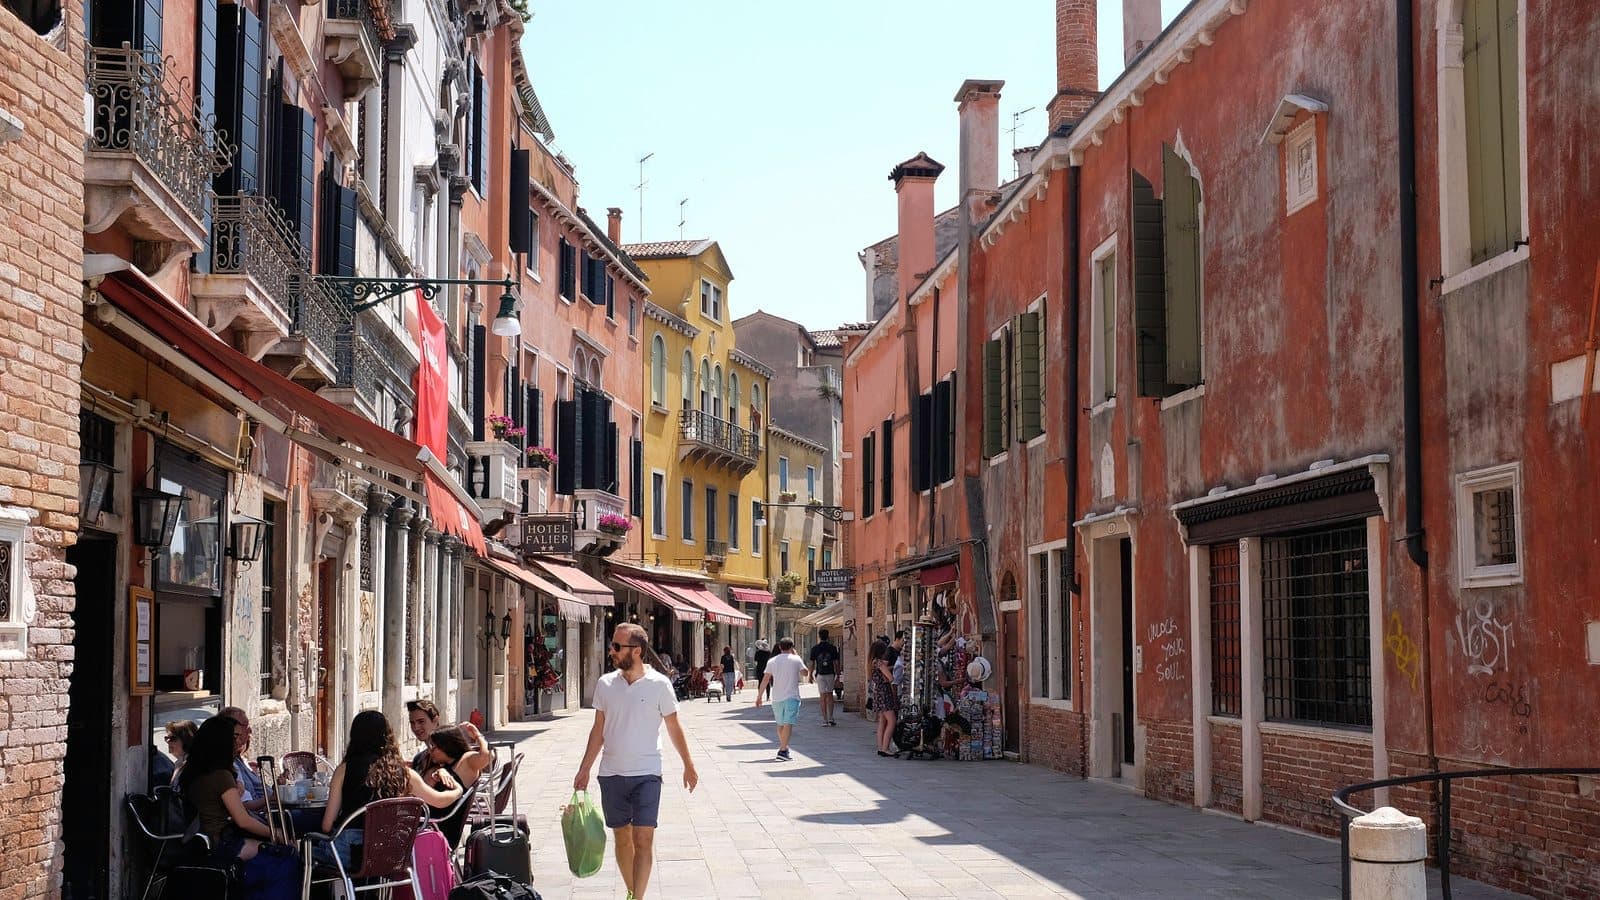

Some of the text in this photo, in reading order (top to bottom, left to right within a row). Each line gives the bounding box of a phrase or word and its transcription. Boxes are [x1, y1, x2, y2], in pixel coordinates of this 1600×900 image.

[527, 524, 568, 534] HOTEL
[526, 535, 569, 545] FALIER
[1161, 637, 1186, 662] YOUR
